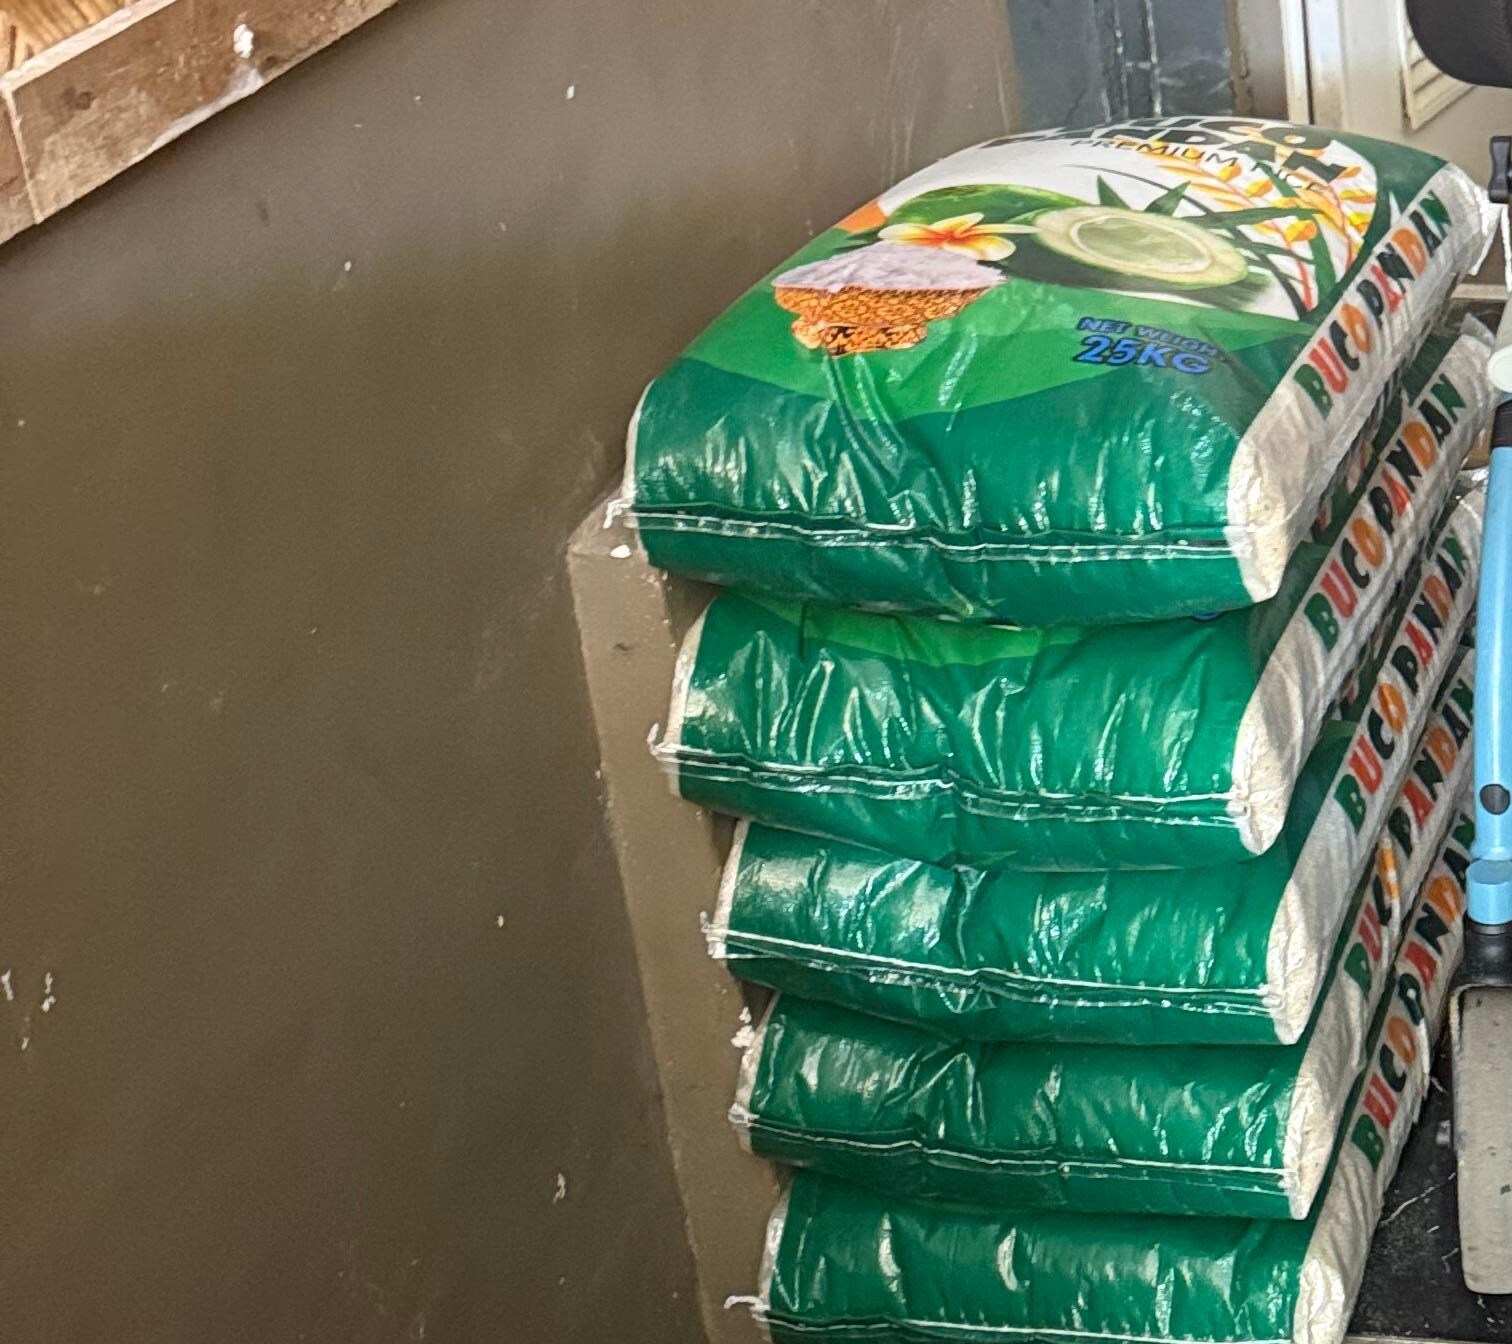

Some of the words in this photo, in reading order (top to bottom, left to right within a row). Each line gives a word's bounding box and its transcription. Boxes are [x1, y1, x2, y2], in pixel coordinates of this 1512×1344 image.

[1070, 139, 1239, 168] PREMIUM
[1073, 334, 1210, 374] 25KG
[1077, 316, 1133, 334] NET
[1293, 303, 1371, 416] BUCO
[1357, 190, 1452, 331] PANDAN
[1304, 518, 1384, 652] BUCO
[1368, 373, 1466, 536] PANDAN
[1333, 682, 1408, 836] BUCO
[1391, 530, 1469, 698] PANDAN
[1343, 846, 1398, 1002] BUCO
[1387, 677, 1474, 860] PANDAN
[1351, 1014, 1417, 1173] BUCO
